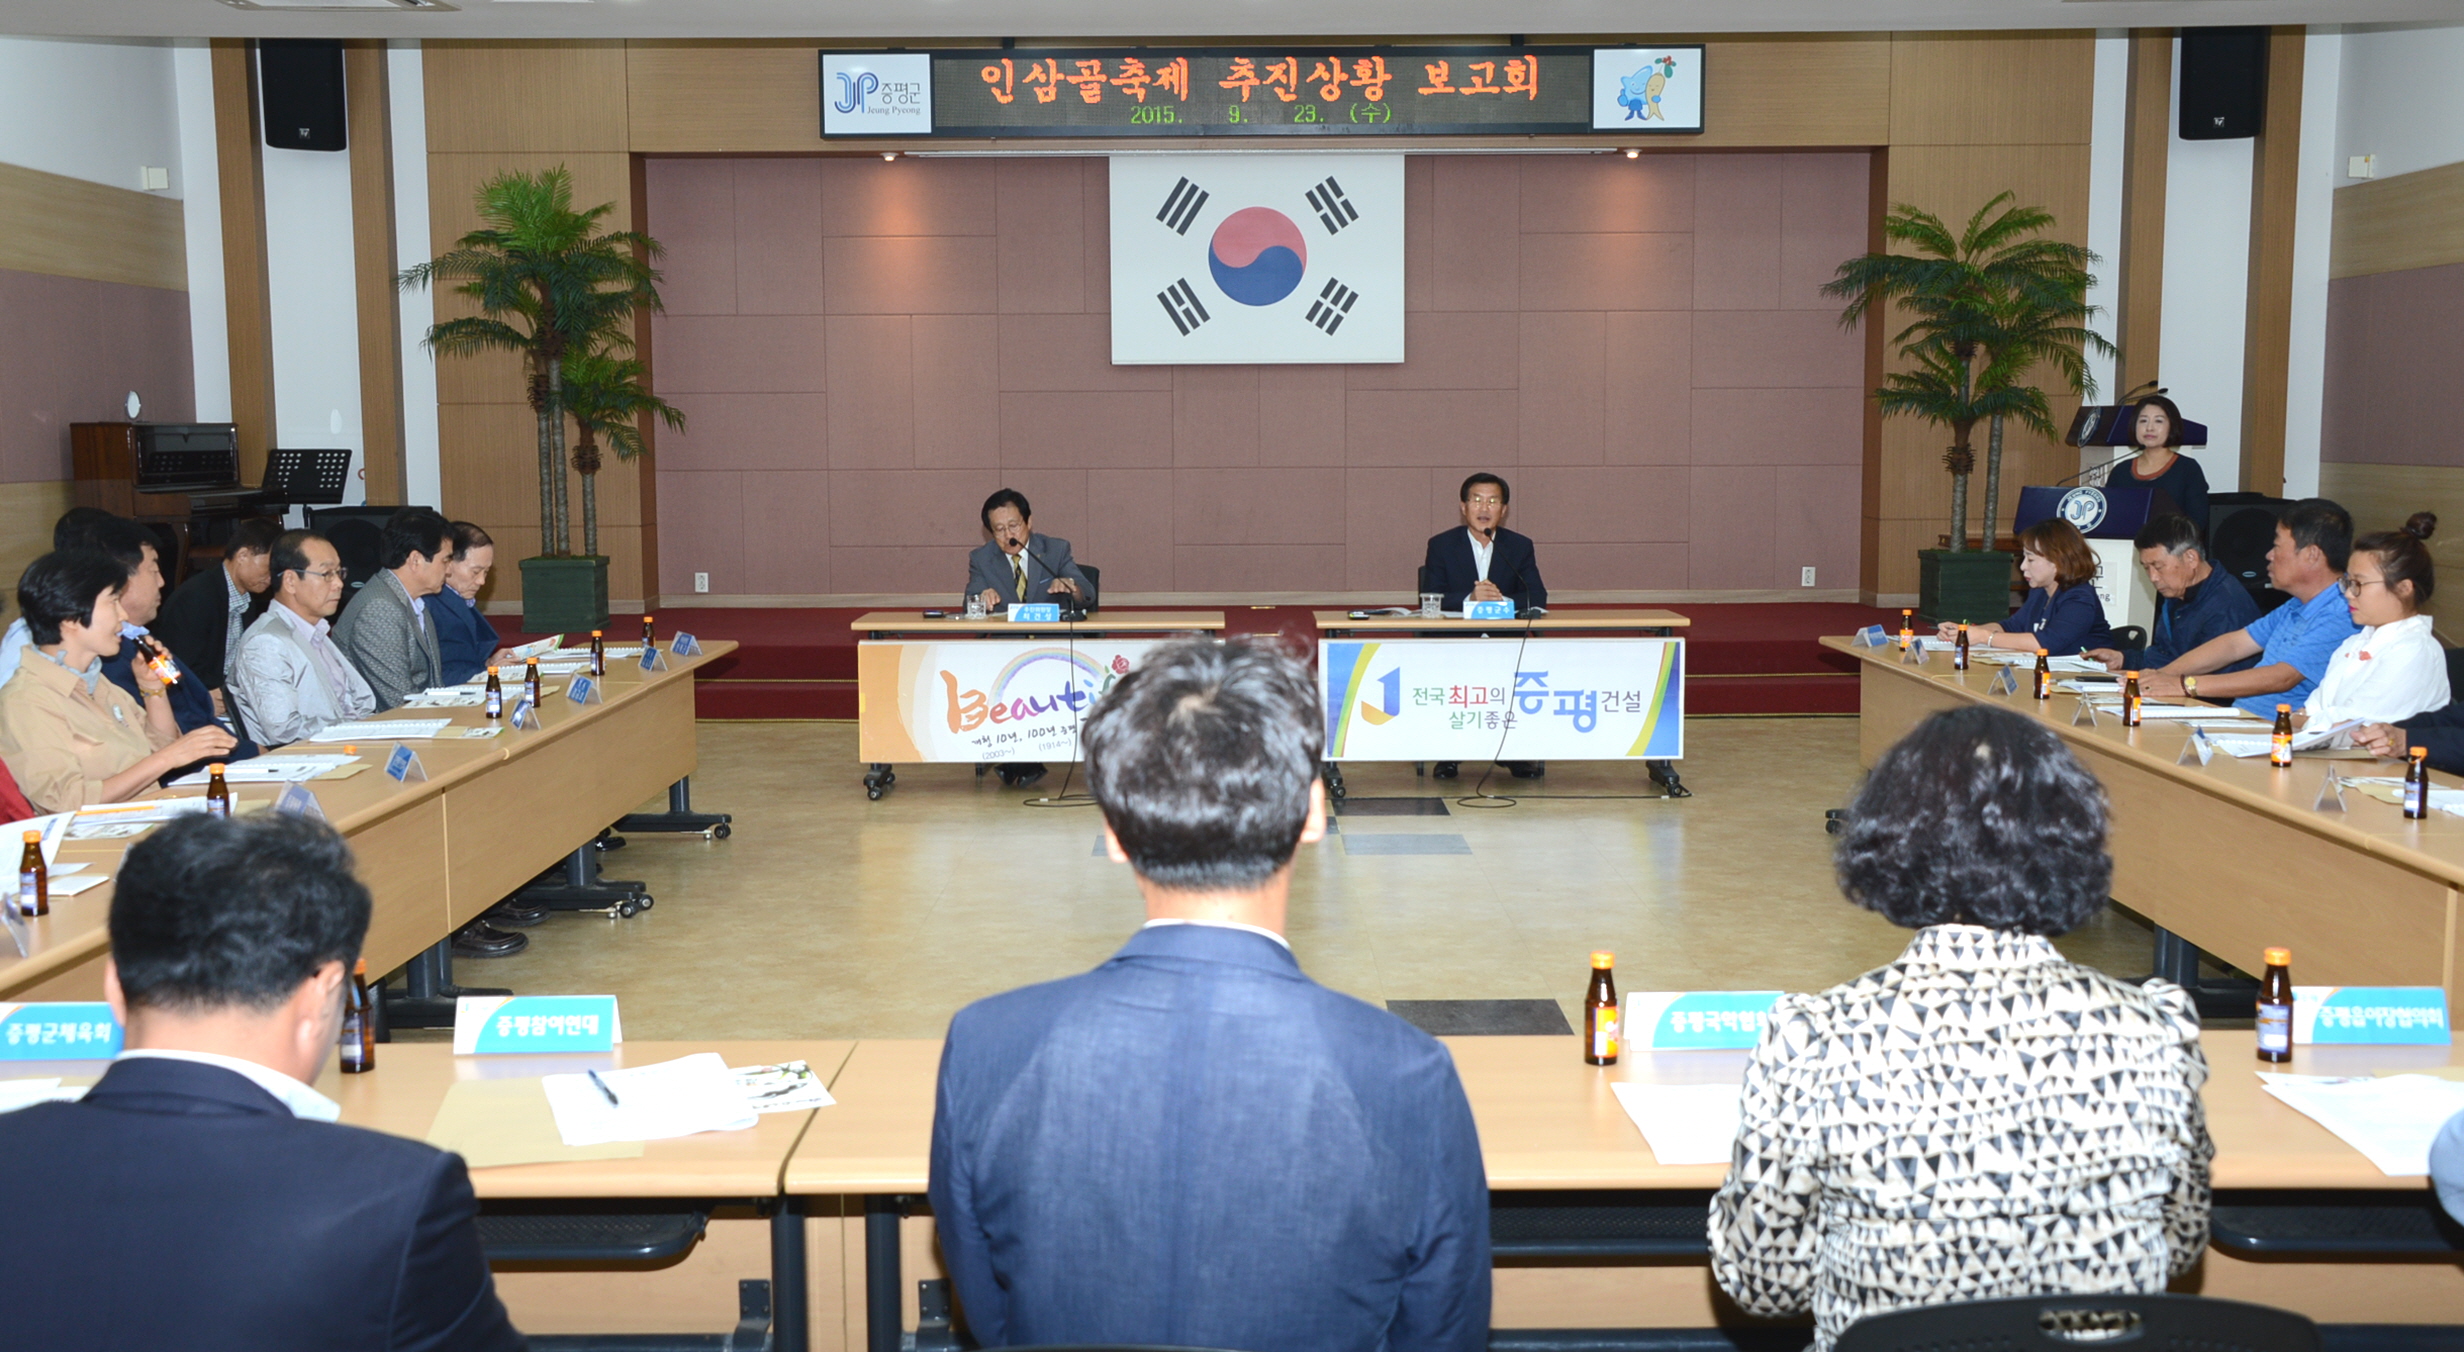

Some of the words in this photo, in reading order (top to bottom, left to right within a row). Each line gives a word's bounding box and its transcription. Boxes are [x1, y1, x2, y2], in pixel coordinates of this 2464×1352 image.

[981, 57, 1189, 104] 인삼골축제
[1218, 56, 1393, 102] 추진상황
[1418, 55, 1538, 100] 보고회
[881, 83, 921, 104] 증평군
[867, 106, 890, 116] Jeung
[892, 106, 921, 116] Pyeong
[1130, 105, 1183, 124] 2015.
[1229, 105, 1249, 123] 9.
[1294, 105, 1324, 123] 23.
[1350, 103, 1392, 123] (수)
[1513, 670, 1598, 733] 증평
[1601, 690, 1642, 713] 건설
[496, 1014, 600, 1037] 증평참여연대
